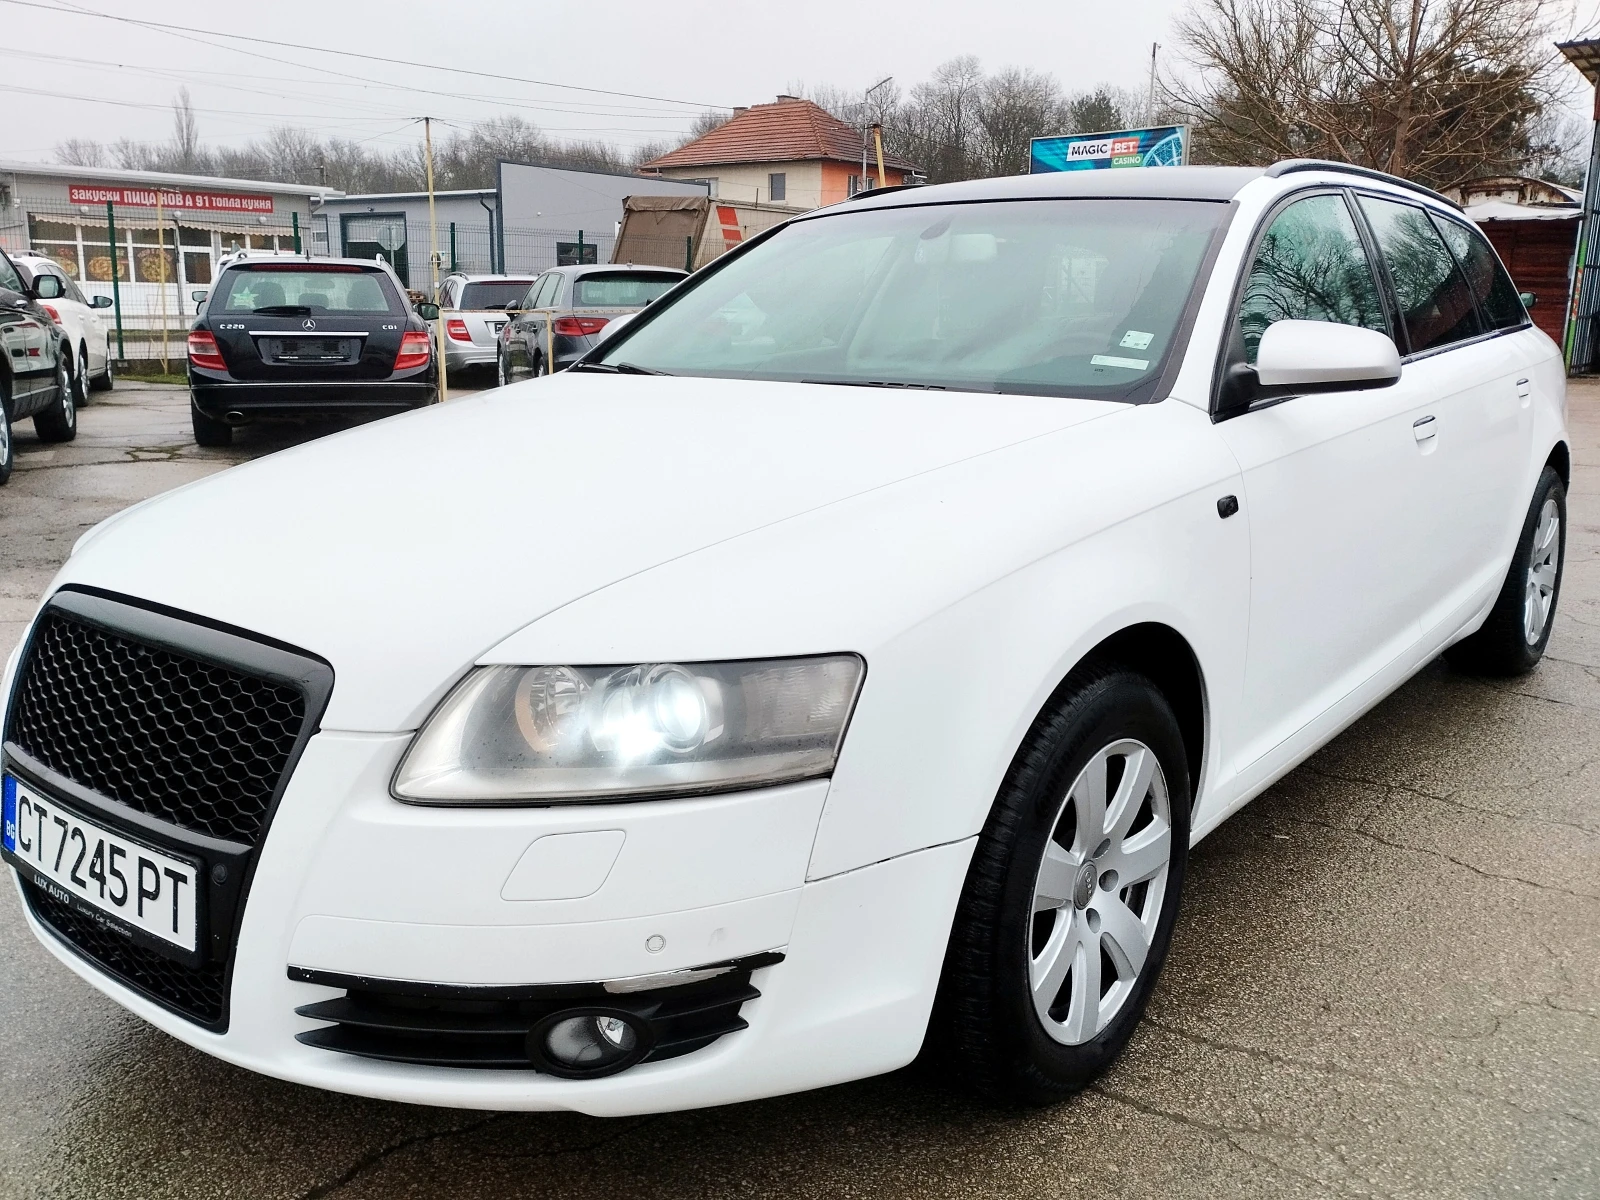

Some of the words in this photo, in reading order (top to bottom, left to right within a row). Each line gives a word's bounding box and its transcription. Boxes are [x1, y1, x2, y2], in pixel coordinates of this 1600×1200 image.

[1071, 144, 1108, 156] MAGIC
[1114, 141, 1137, 153] BET
[1113, 156, 1141, 165] CASINO
[123, 191, 157, 206] ПИЦА
[195, 195, 210, 208] 91
[6, 819, 15, 840] BG
[34, 874, 48, 892] LUX
[48, 884, 70, 904] AUTO
[76, 903, 95, 919] Luxury
[95, 913, 106, 924] Car
[105, 919, 133, 938] Selection
